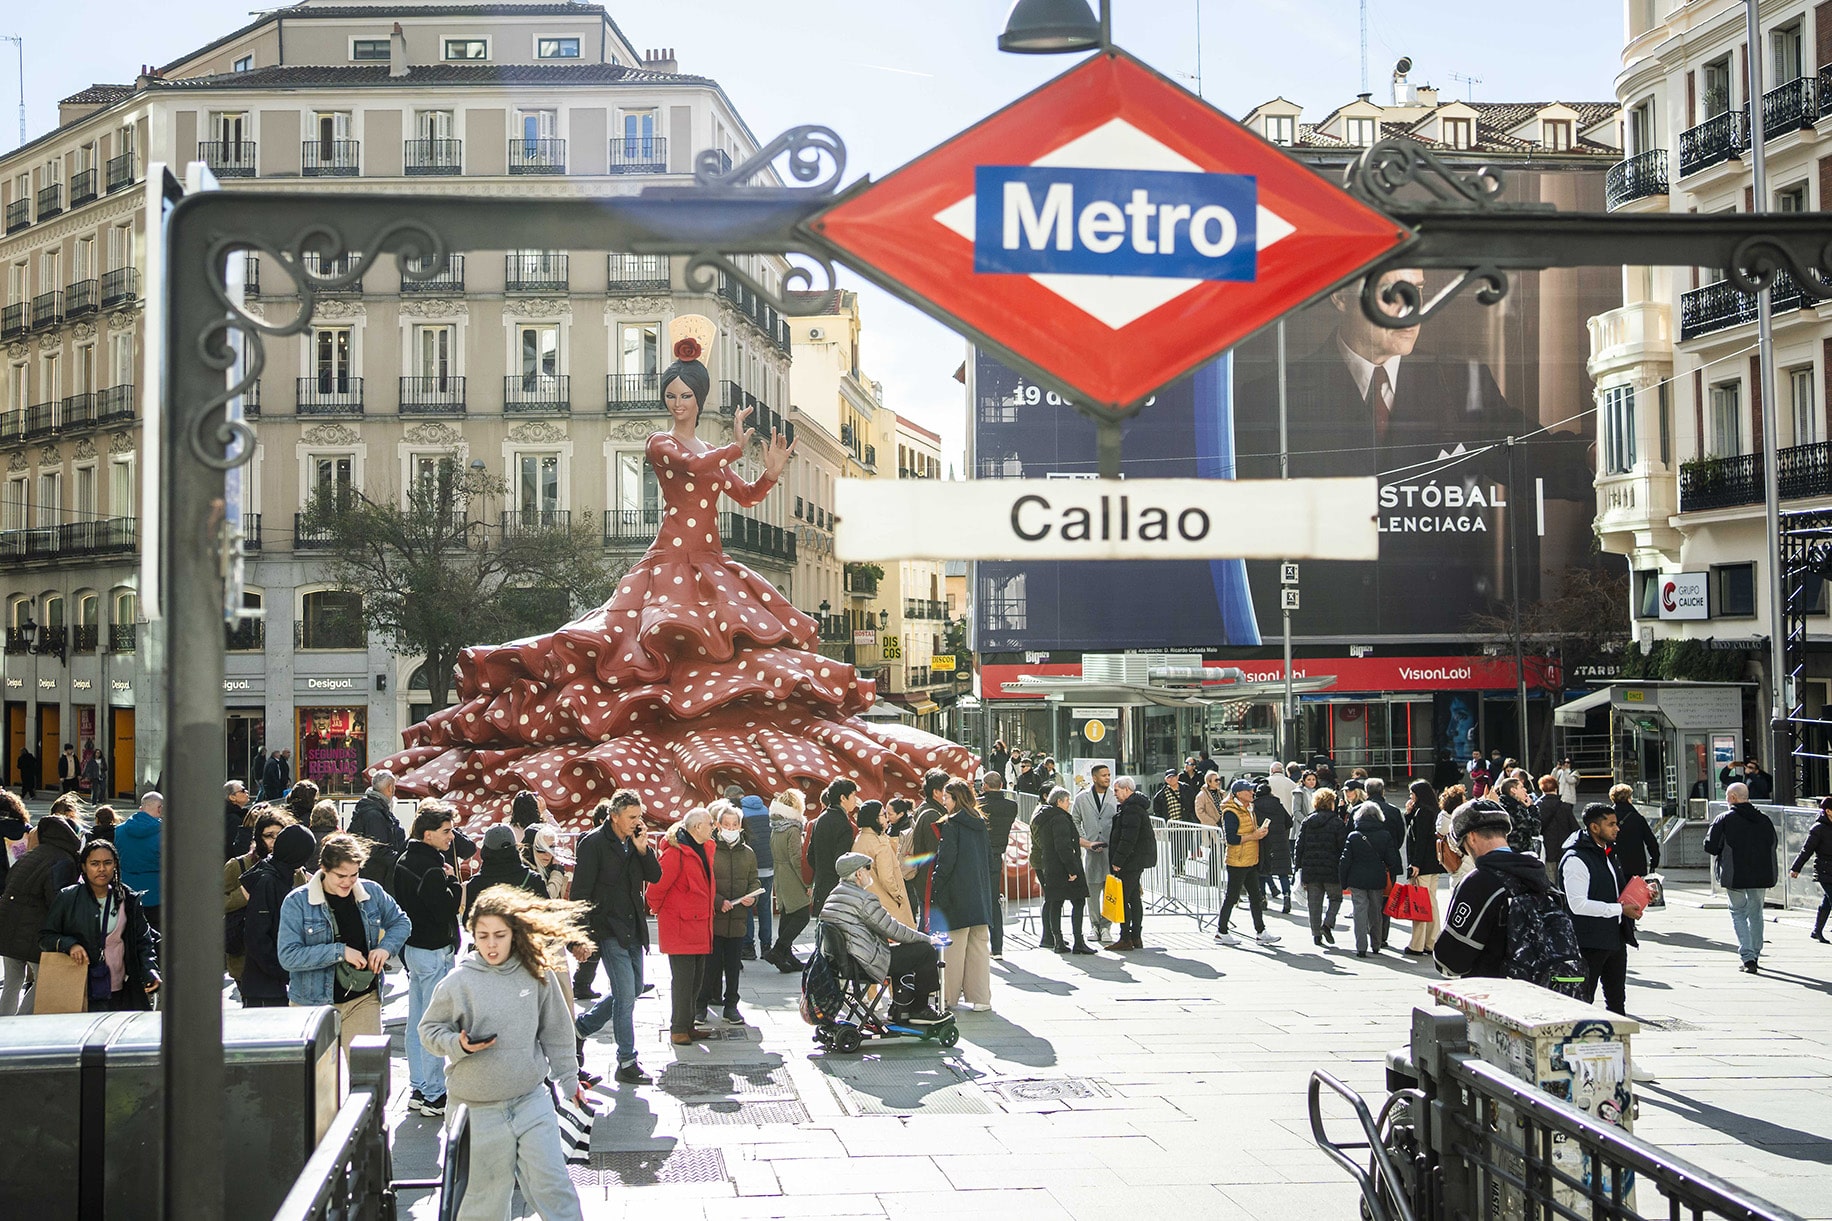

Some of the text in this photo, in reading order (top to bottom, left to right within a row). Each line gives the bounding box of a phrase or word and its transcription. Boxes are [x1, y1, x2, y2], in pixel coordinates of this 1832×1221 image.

[1003, 181, 1237, 257] Metro
[1013, 385, 1041, 406] 19
[1379, 479, 1507, 508] STÓBAL
[1010, 494, 1210, 542] Callao
[1377, 516, 1487, 532] LENCIAGA
[1678, 585, 1700, 595] GRUPO
[883, 636, 898, 647] DIS
[883, 648, 901, 659] COS
[1399, 666, 1471, 680] VisionLab!
[308, 678, 352, 690] Desigual.
[308, 748, 357, 760] SEGUNDAS
[309, 760, 358, 774] REBAJAS
[1452, 901, 1472, 928] 8
[1554, 1134, 1566, 1143] 42
